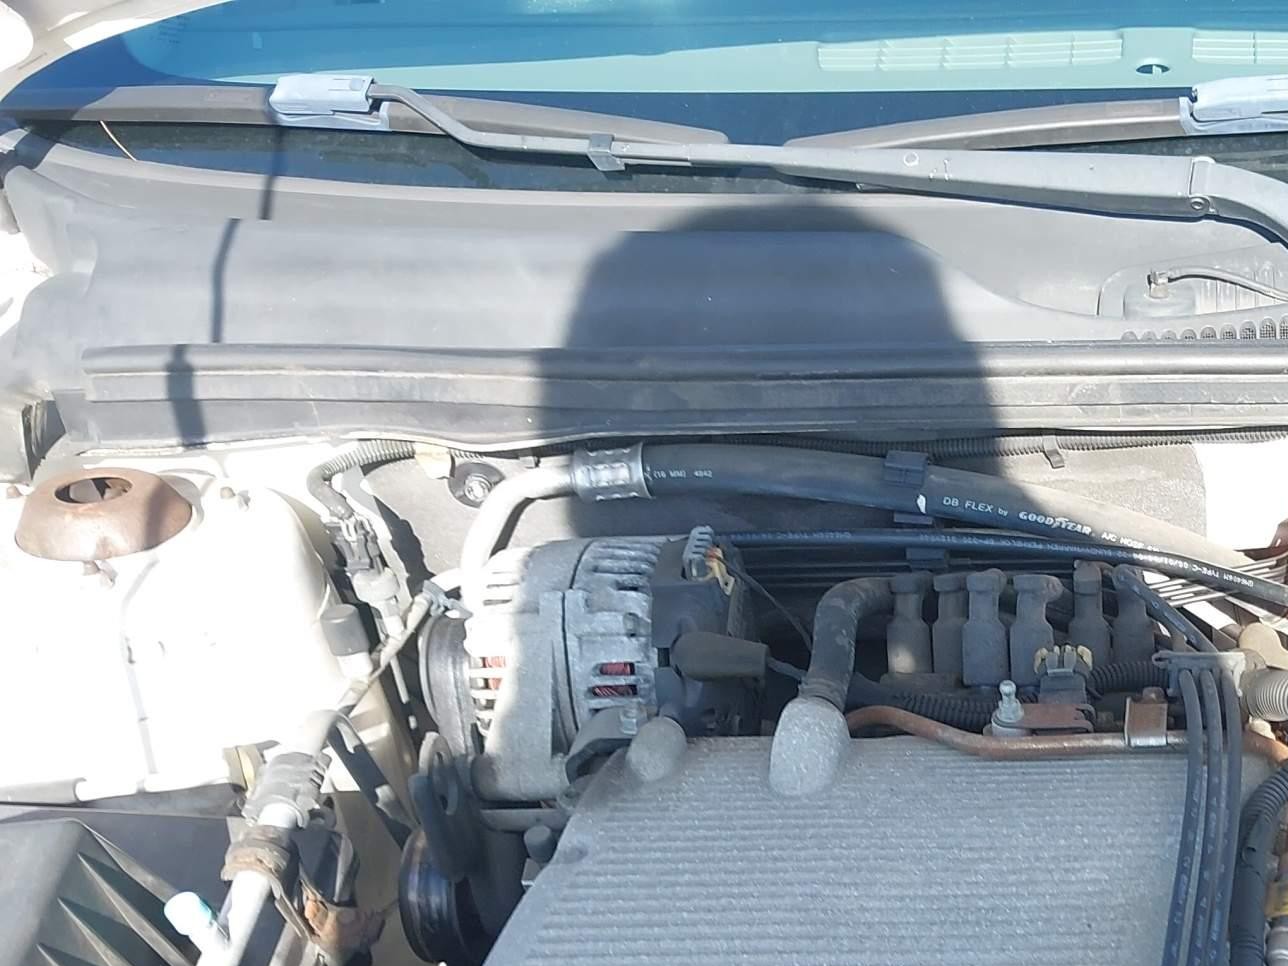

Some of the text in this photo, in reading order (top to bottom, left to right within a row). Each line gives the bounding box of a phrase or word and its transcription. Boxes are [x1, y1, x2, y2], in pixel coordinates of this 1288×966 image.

[943, 496, 960, 507] DB
[965, 500, 994, 513] FLEX
[998, 507, 1009, 517] by
[1018, 510, 1092, 537] GOODYEAR
